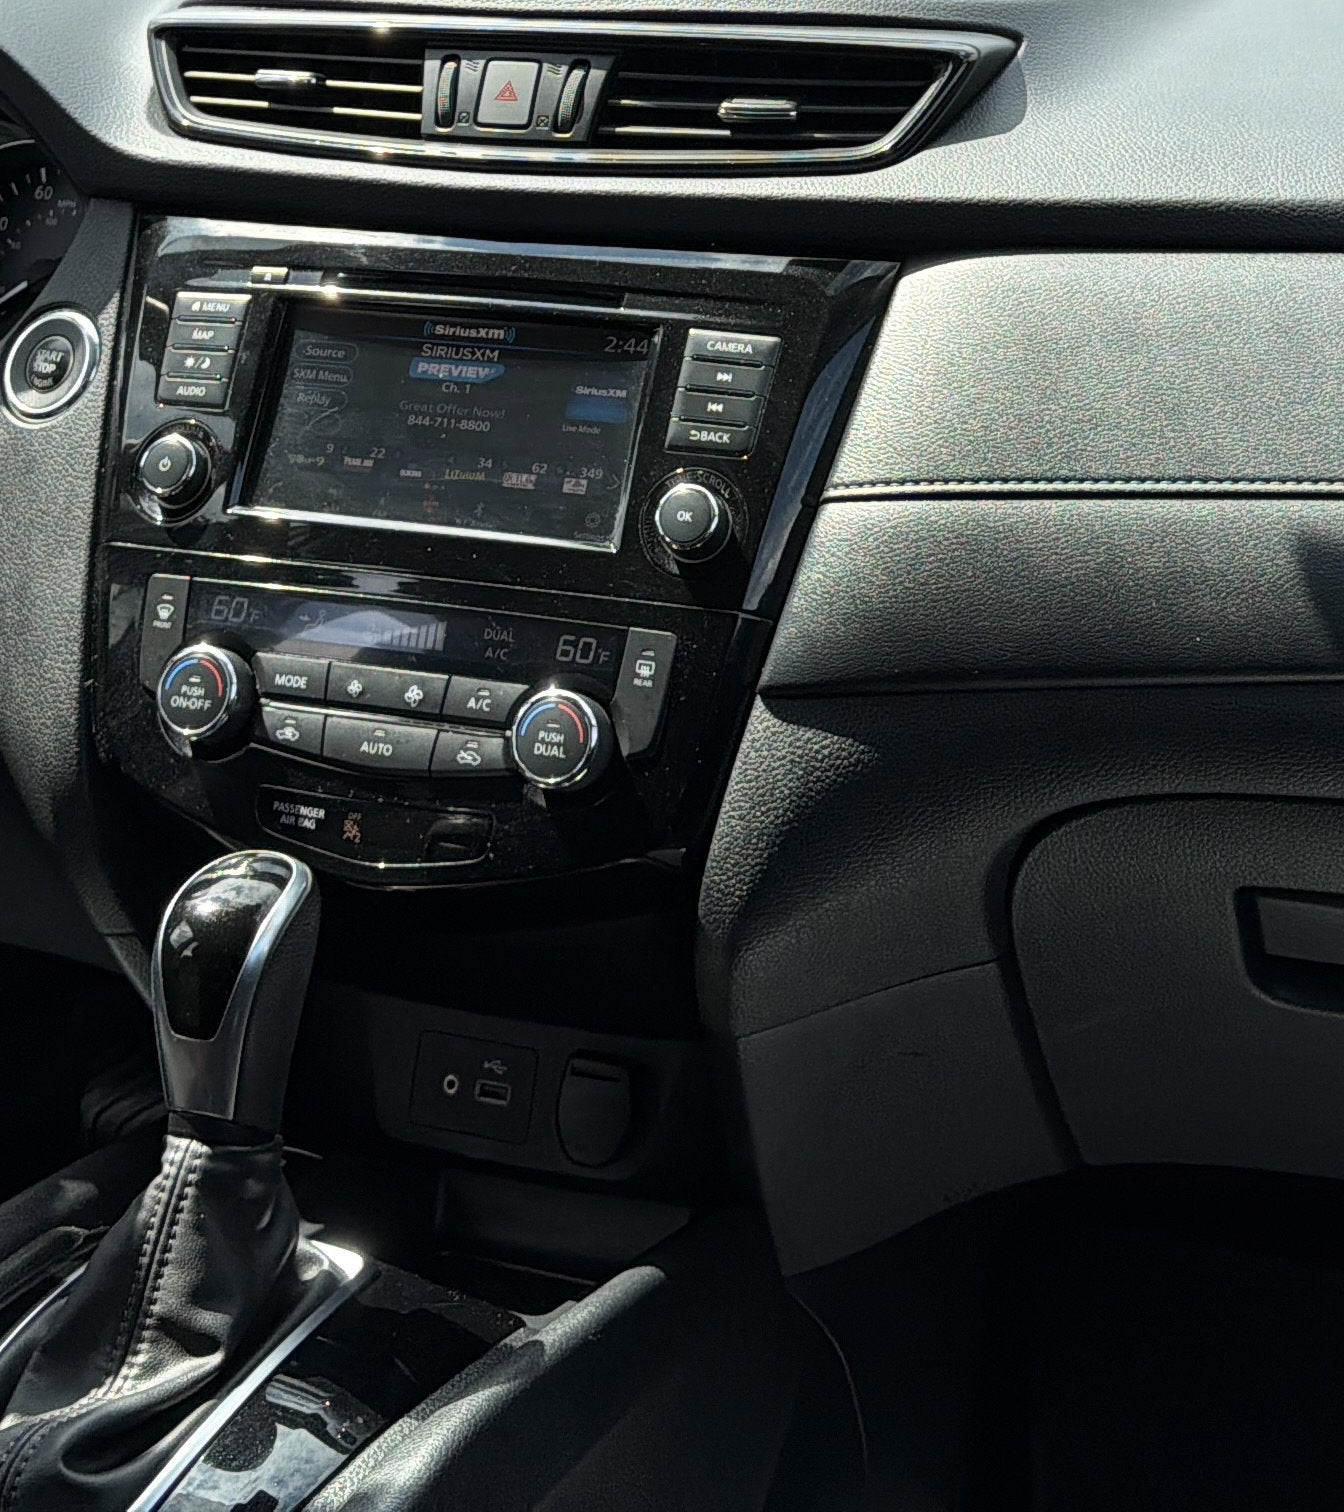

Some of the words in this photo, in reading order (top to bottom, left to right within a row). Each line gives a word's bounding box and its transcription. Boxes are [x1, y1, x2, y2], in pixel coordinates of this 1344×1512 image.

[34, 185, 54, 201] 60
[201, 302, 231, 313] MENU
[191, 329, 215, 341] MAP
[304, 345, 346, 359] Source
[421, 343, 501, 362] SIRIUSXM
[603, 336, 650, 355] 2:44
[706, 340, 754, 355] CAMERA
[35, 349, 65, 362] START
[33, 361, 57, 374] STOP
[417, 361, 491, 379] PREVIEW
[293, 368, 316, 380] SXM
[318, 369, 349, 383] Menu
[175, 385, 207, 397] AUDIO
[441, 382, 461, 394] Ch.
[297, 390, 332, 407] Replay
[399, 400, 433, 414] Great
[437, 403, 469, 417] Offer
[472, 406, 506, 420] Now!
[407, 414, 492, 432] 844-711-8800
[700, 431, 732, 445] BACK
[369, 447, 387, 459] 22
[477, 457, 494, 468] 34
[531, 463, 549, 474] 62
[579, 467, 604, 479] 349
[676, 509, 694, 523] OK
[483, 628, 515, 643] DUAL
[483, 647, 510, 662] A/C
[275, 673, 308, 689] MODE
[632, 677, 654, 688] REAR
[180, 684, 206, 698] PUSH
[466, 696, 493, 713] A/C
[537, 729, 565, 745] PUSH
[359, 740, 393, 757] AUTO
[532, 742, 567, 760] DUAL
[273, 800, 326, 821] PASSENGER
[279, 813, 297, 826] AIR
